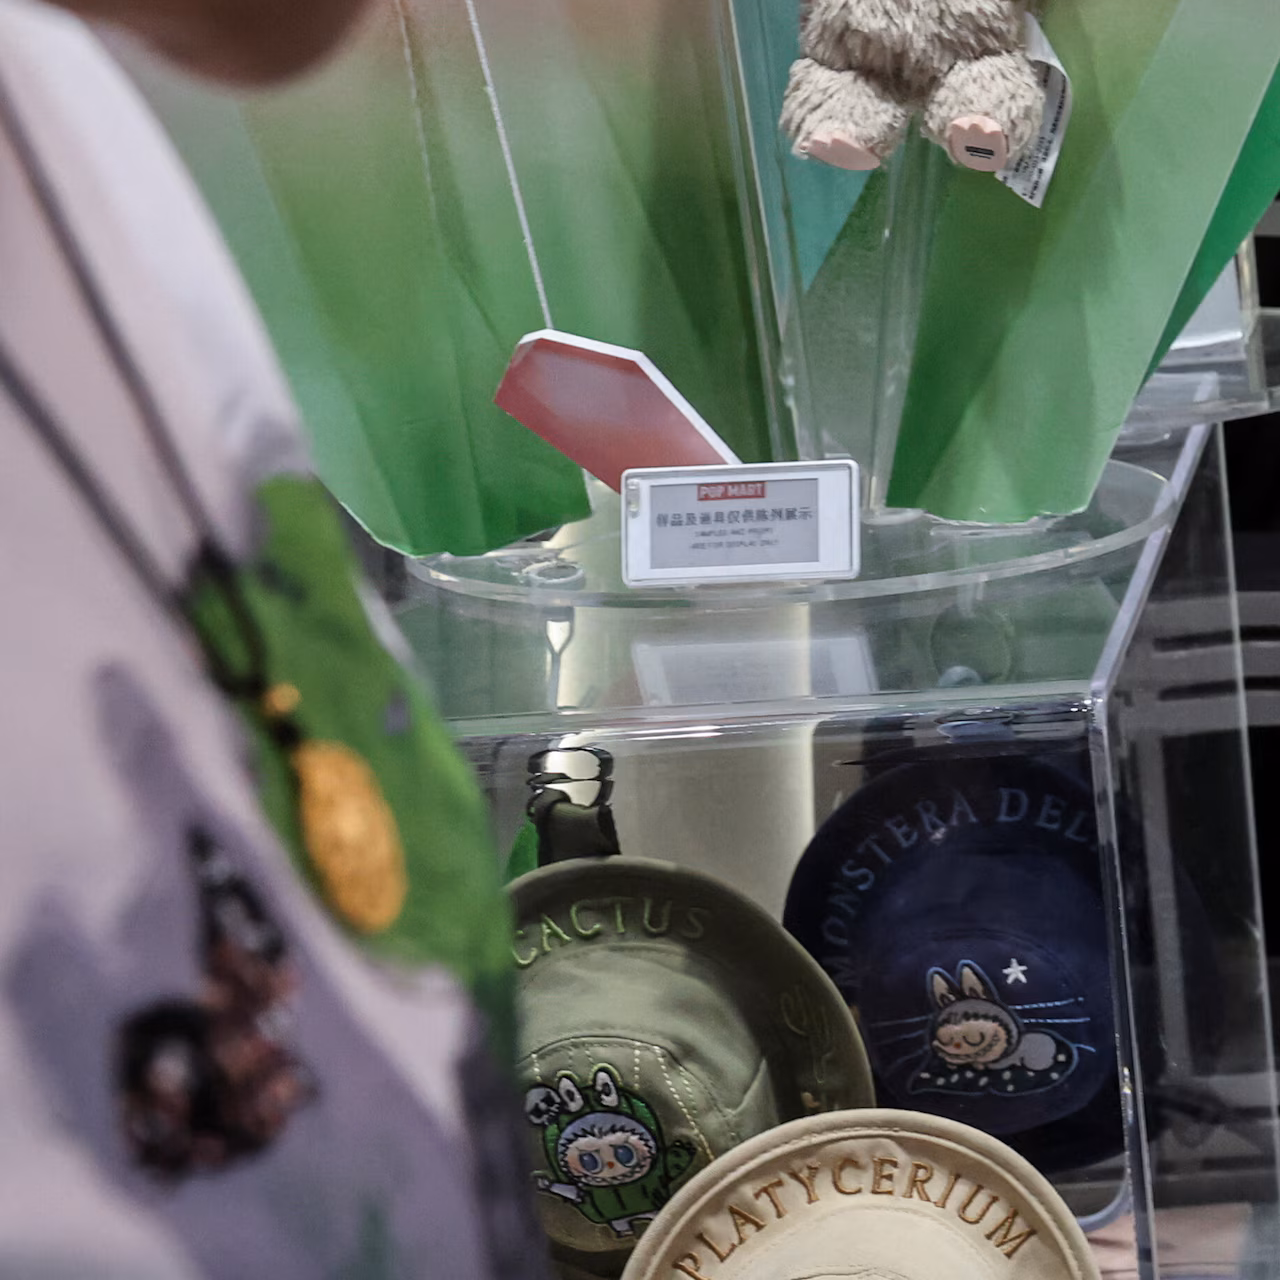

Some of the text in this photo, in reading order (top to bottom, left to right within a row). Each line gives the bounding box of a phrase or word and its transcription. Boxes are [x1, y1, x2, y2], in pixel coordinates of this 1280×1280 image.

[699, 482, 764, 499] POP MART
[510, 896, 714, 969] CACTUS
[820, 787, 980, 988] MONSTERA
[671, 1155, 1039, 1280] PLATYCERIUM
